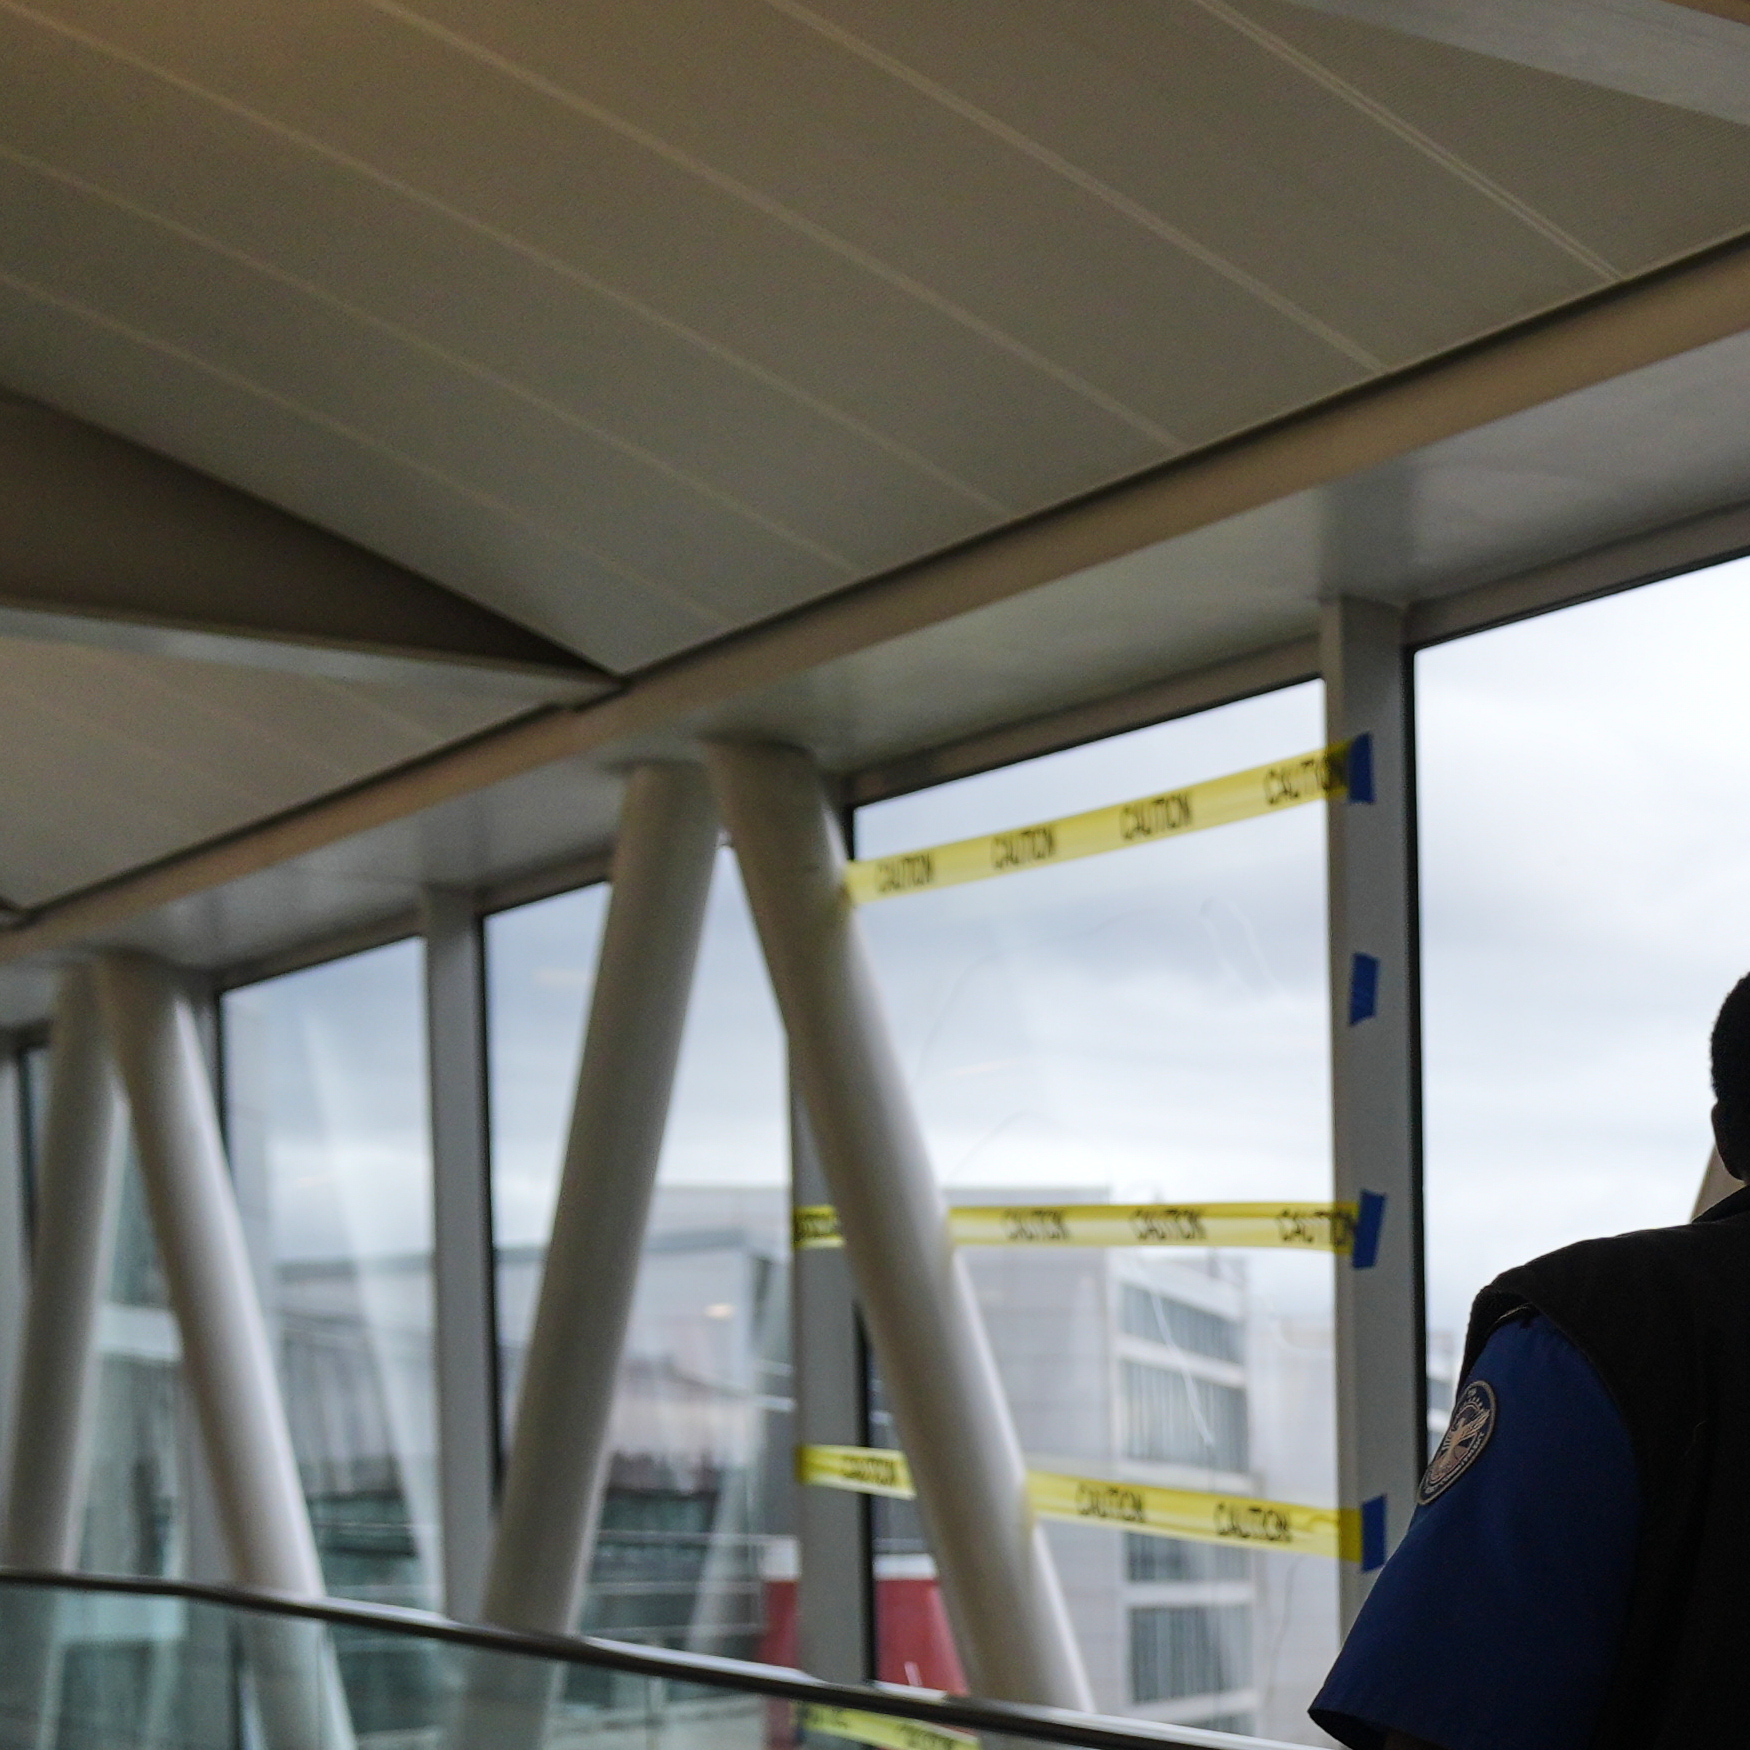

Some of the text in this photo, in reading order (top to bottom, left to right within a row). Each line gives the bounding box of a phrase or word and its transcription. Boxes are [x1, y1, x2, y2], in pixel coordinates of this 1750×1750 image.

[990, 826, 1057, 870] CAUTION
[1119, 790, 1193, 841] CAUTION
[1263, 752, 1348, 806] CAUTIO
[1002, 1207, 1359, 1247] CAUTION CAUTION CAUTIO
[1075, 1481, 1147, 1524] CAUTION
[1214, 1501, 1293, 1543] CAUTION
